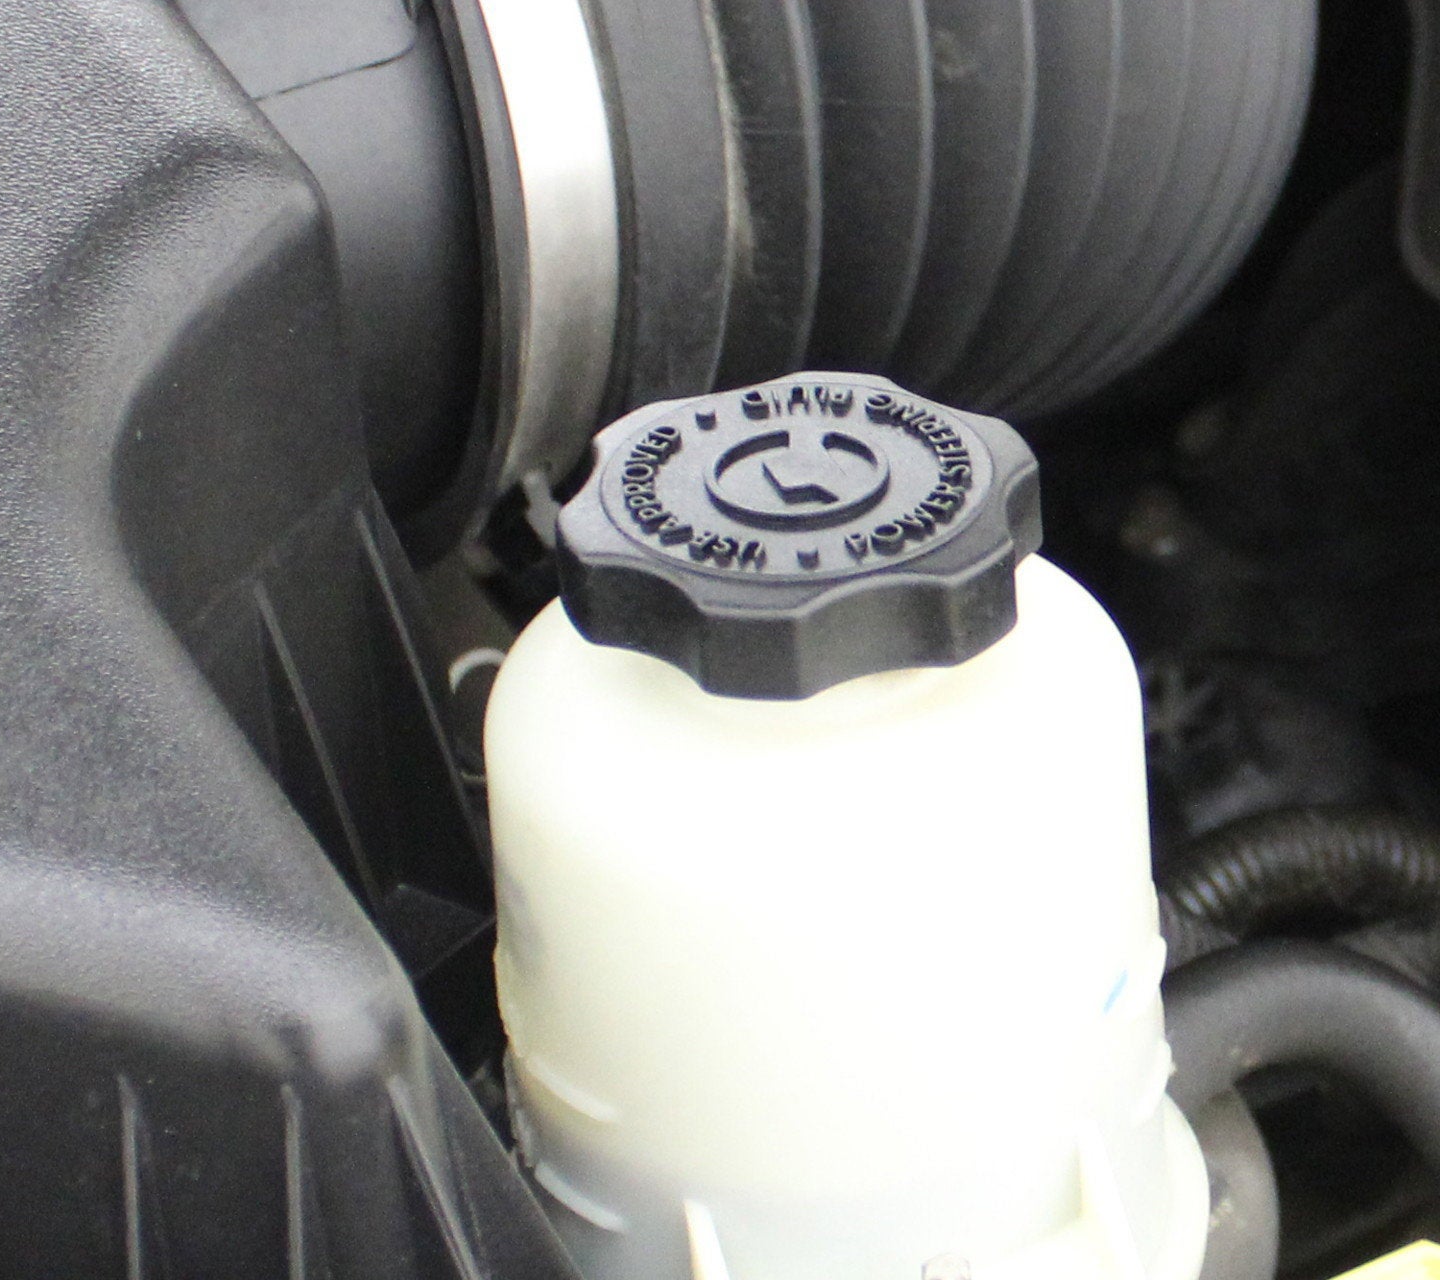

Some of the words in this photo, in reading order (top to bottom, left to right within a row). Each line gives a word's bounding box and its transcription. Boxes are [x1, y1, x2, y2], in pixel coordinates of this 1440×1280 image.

[742, 386, 854, 421] FLUID
[865, 390, 973, 486] STEERING
[622, 424, 690, 545] APPROVED
[844, 477, 970, 562] POWER
[688, 531, 766, 570] USE
